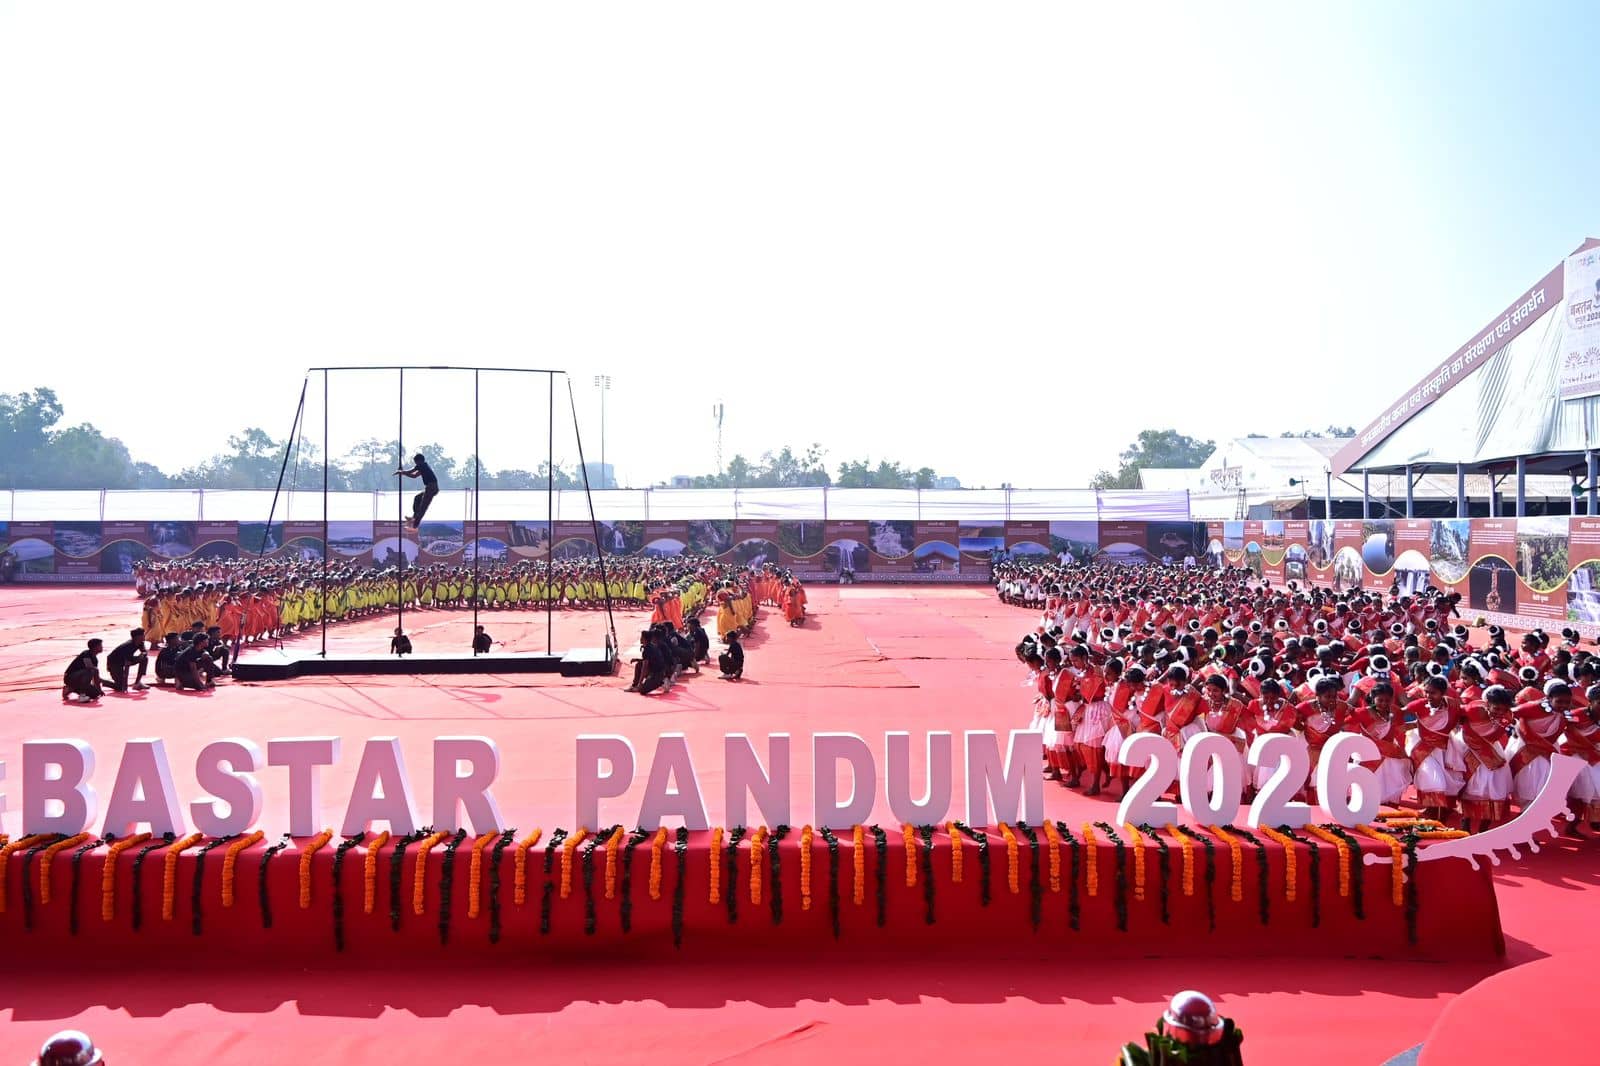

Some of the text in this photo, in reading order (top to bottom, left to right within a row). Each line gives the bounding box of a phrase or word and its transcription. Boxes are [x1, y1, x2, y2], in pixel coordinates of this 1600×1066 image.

[1409, 386, 1421, 408] एवं
[1421, 364, 1451, 398] संस्कृति
[1450, 355, 1464, 375] का
[1463, 330, 1496, 364] संरक्षण
[1495, 313, 1511, 339] एवं
[1510, 287, 1545, 326] संवर्धन
[0, 730, 1383, 839] BASTAR PANDUM 2026
